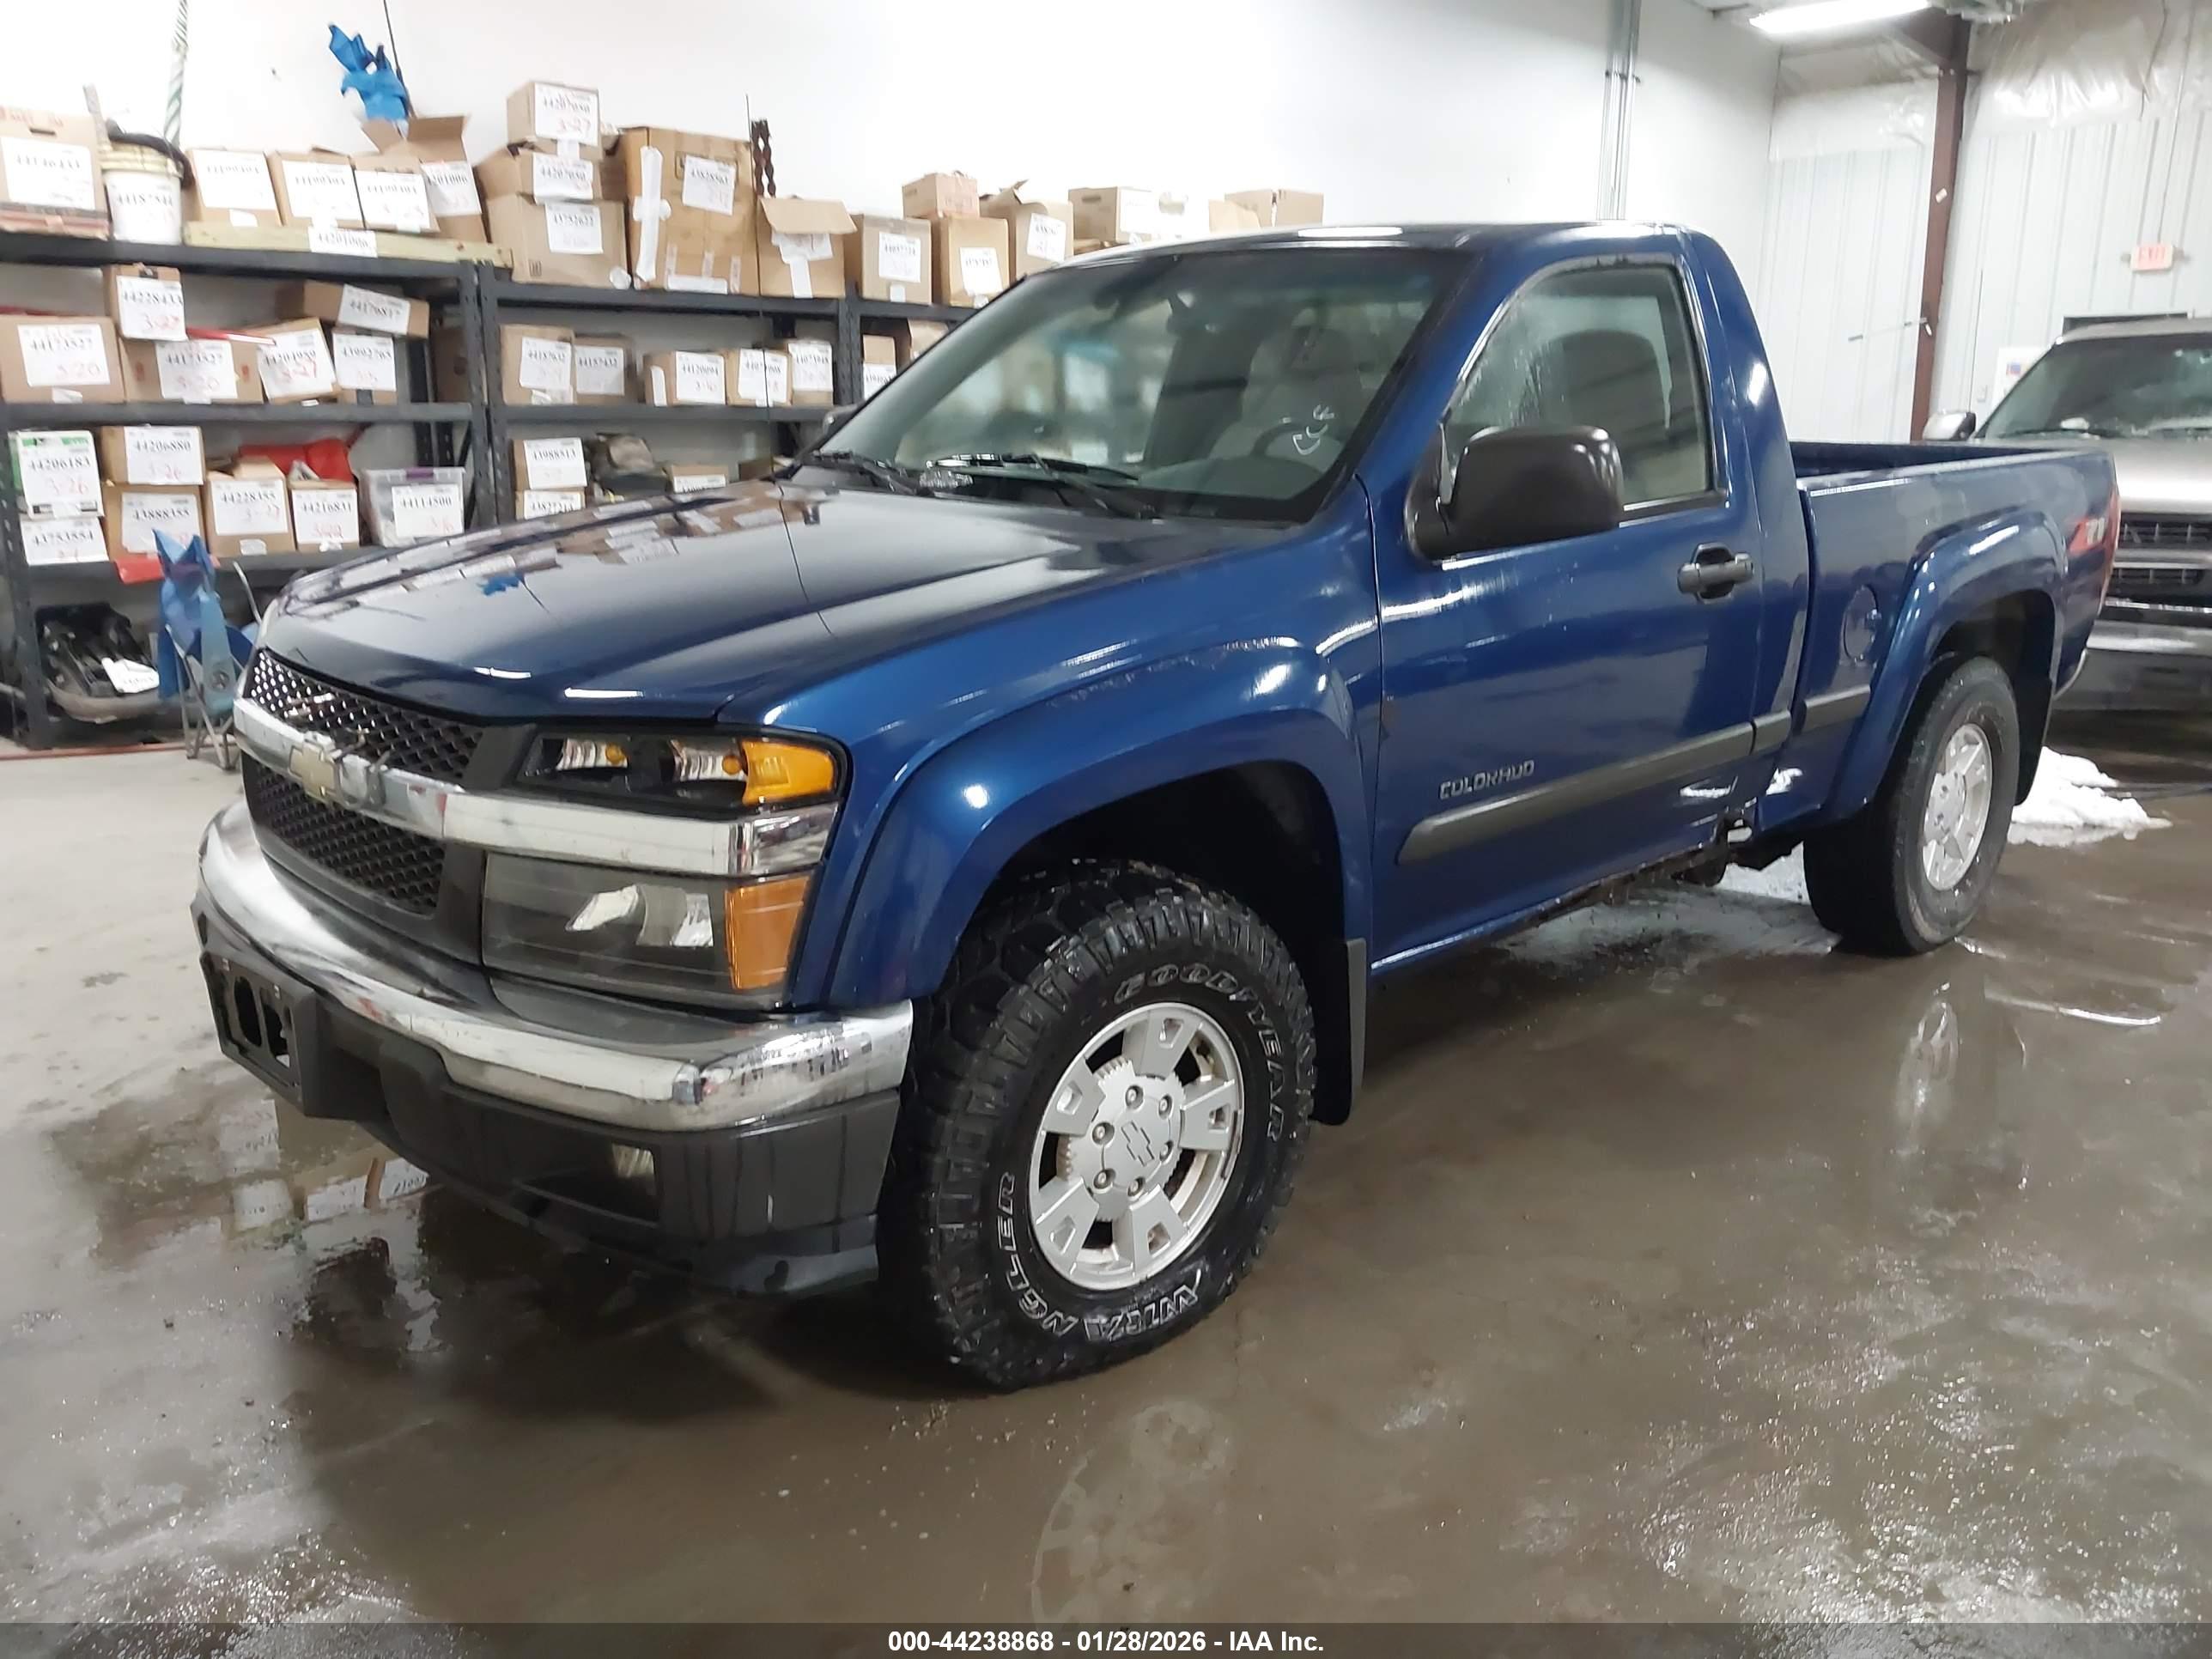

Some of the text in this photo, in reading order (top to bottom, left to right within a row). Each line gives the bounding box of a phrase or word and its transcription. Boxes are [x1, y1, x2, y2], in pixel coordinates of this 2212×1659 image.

[1438, 759, 1535, 800] COLORADO
[1113, 963, 1286, 1143] GOODYEAR
[996, 1170, 1202, 1342] WRANGLER
